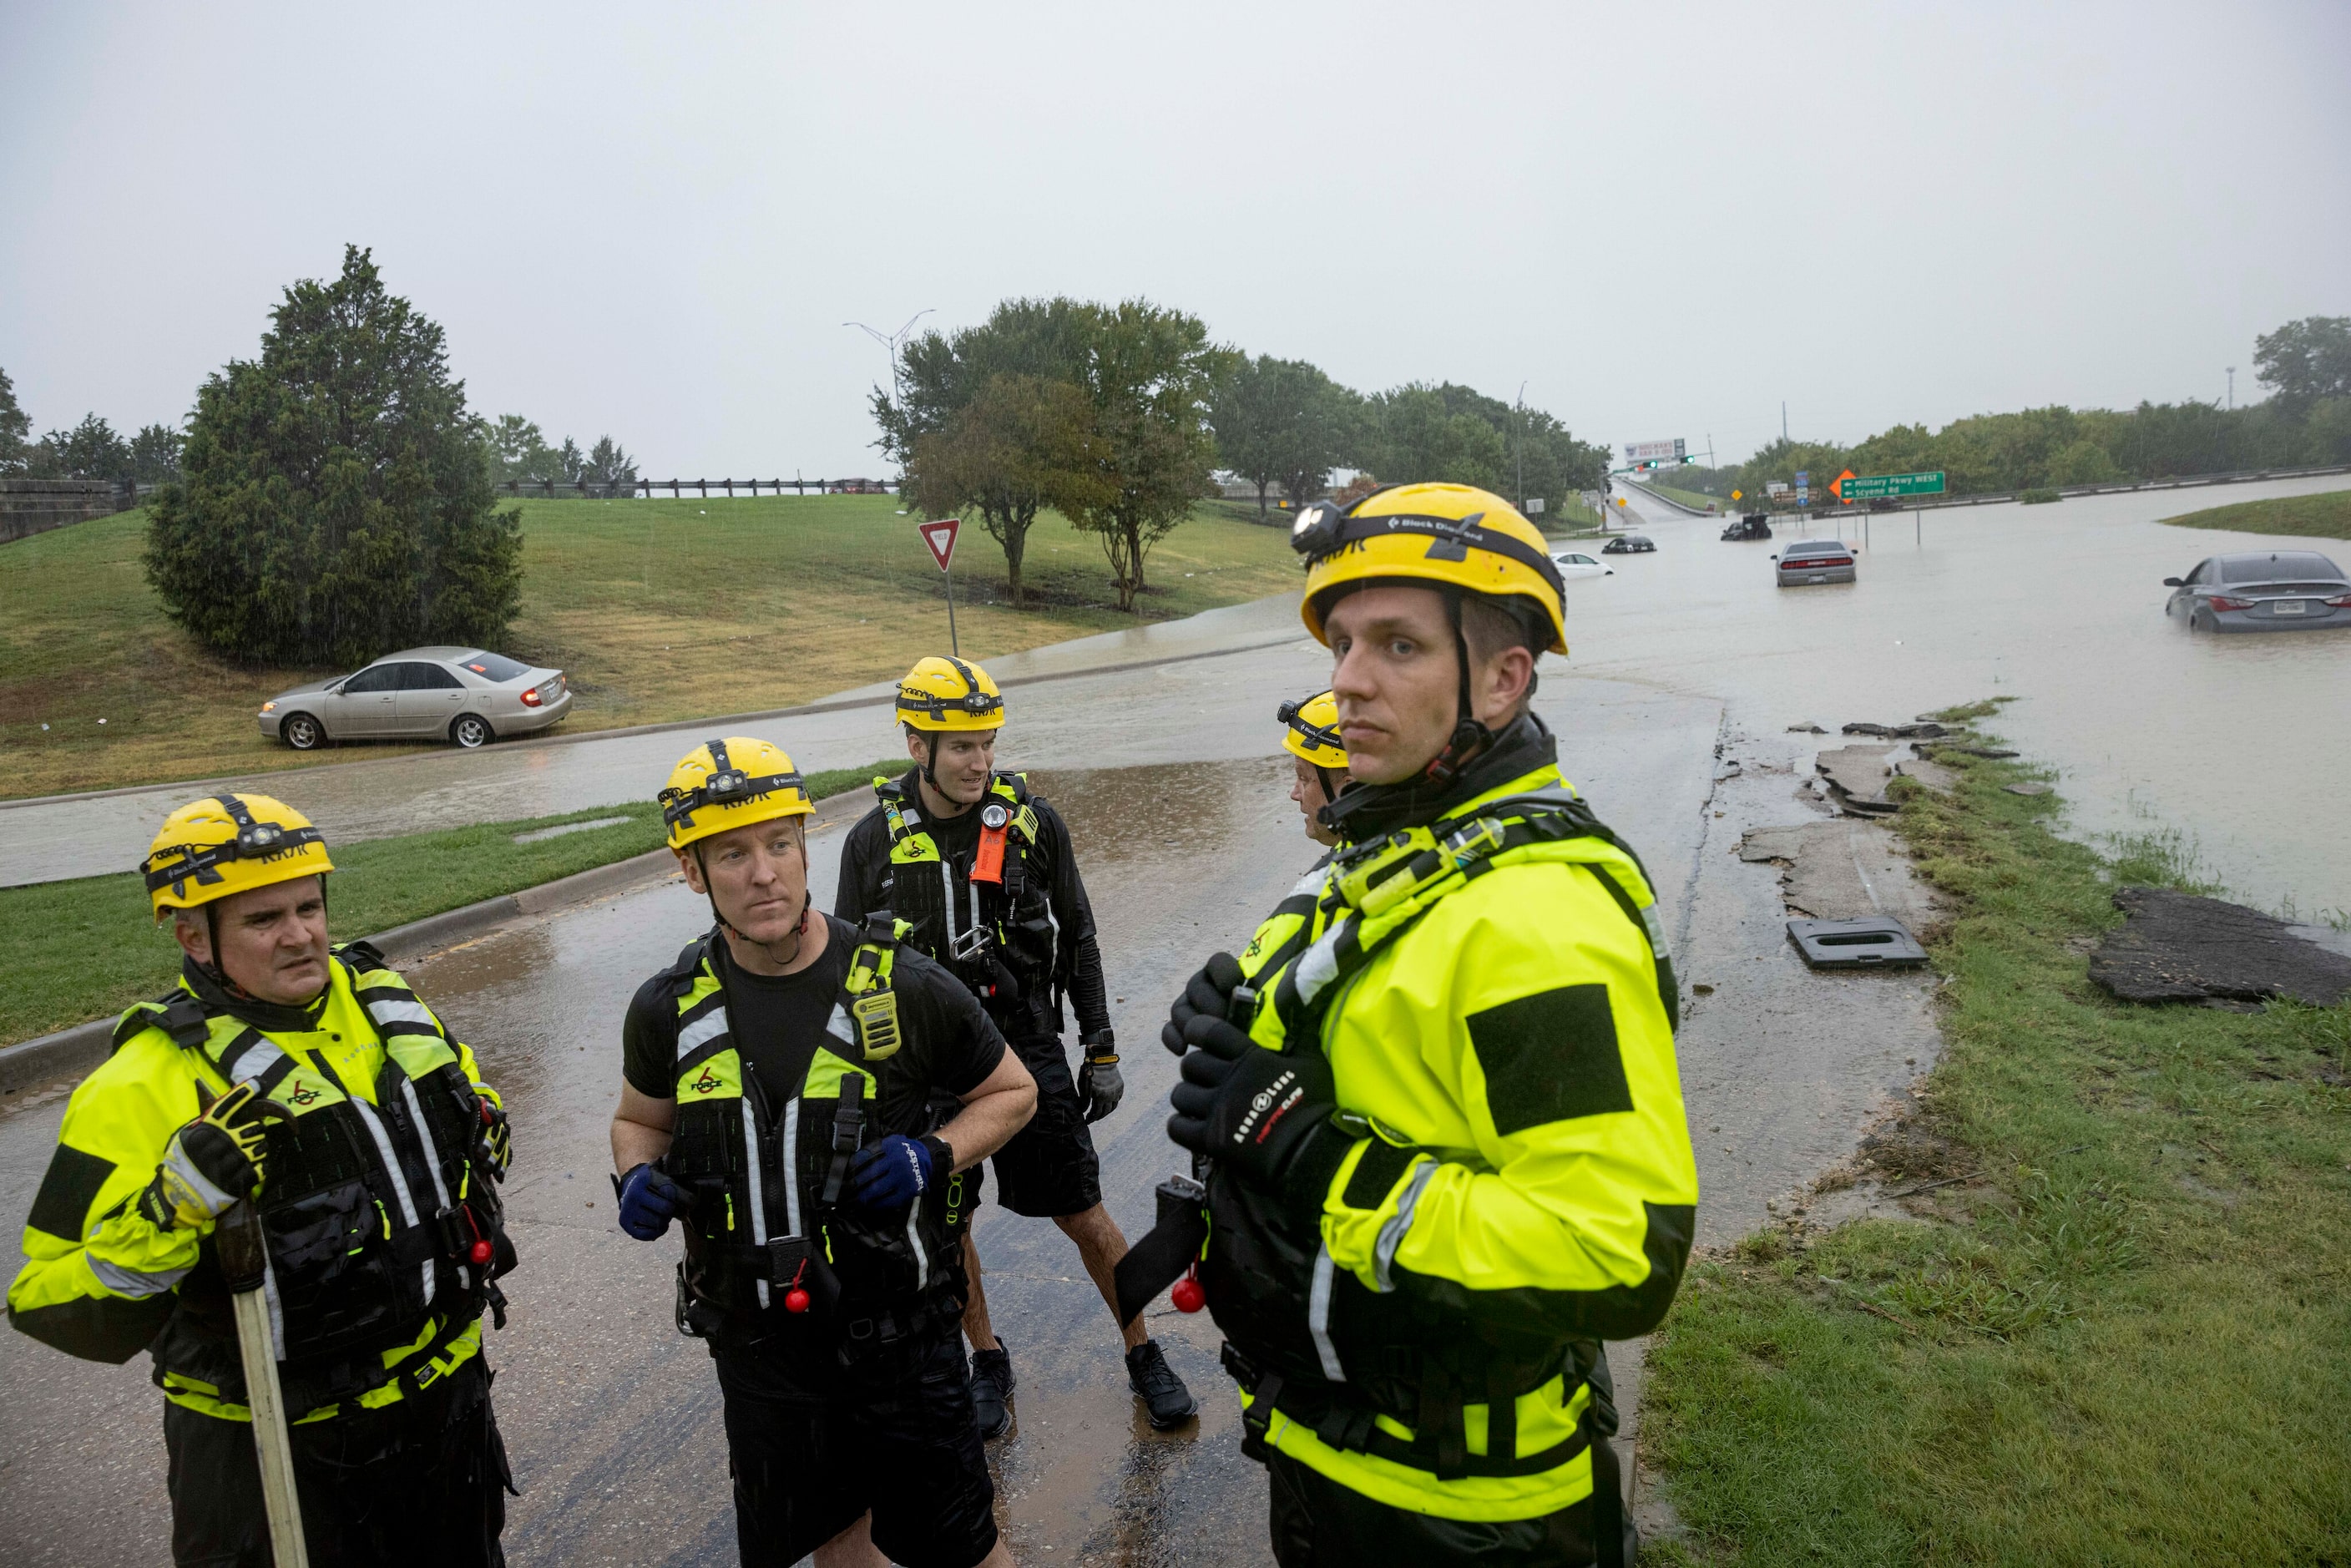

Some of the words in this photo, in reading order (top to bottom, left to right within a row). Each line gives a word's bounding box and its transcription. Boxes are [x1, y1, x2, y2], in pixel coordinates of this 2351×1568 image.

[1855, 478, 1886, 487] Military
[1890, 477, 1912, 485] Pkwy
[1915, 474, 1937, 483] WEST
[1855, 488, 1885, 497] Scyene
[1888, 486, 1899, 494] Rd
[934, 533, 948, 541] YIELD
[1402, 518, 1433, 529] Black
[1436, 522, 1484, 542] Diaond
[1304, 726, 1317, 736] Black
[1318, 735, 1340, 745] iamond
[691, 1080, 722, 1090] FORCE
[287, 1090, 322, 1105] FORCE
[1233, 1110, 1260, 1144] AQUA
[1266, 1070, 1296, 1096] LUNG
